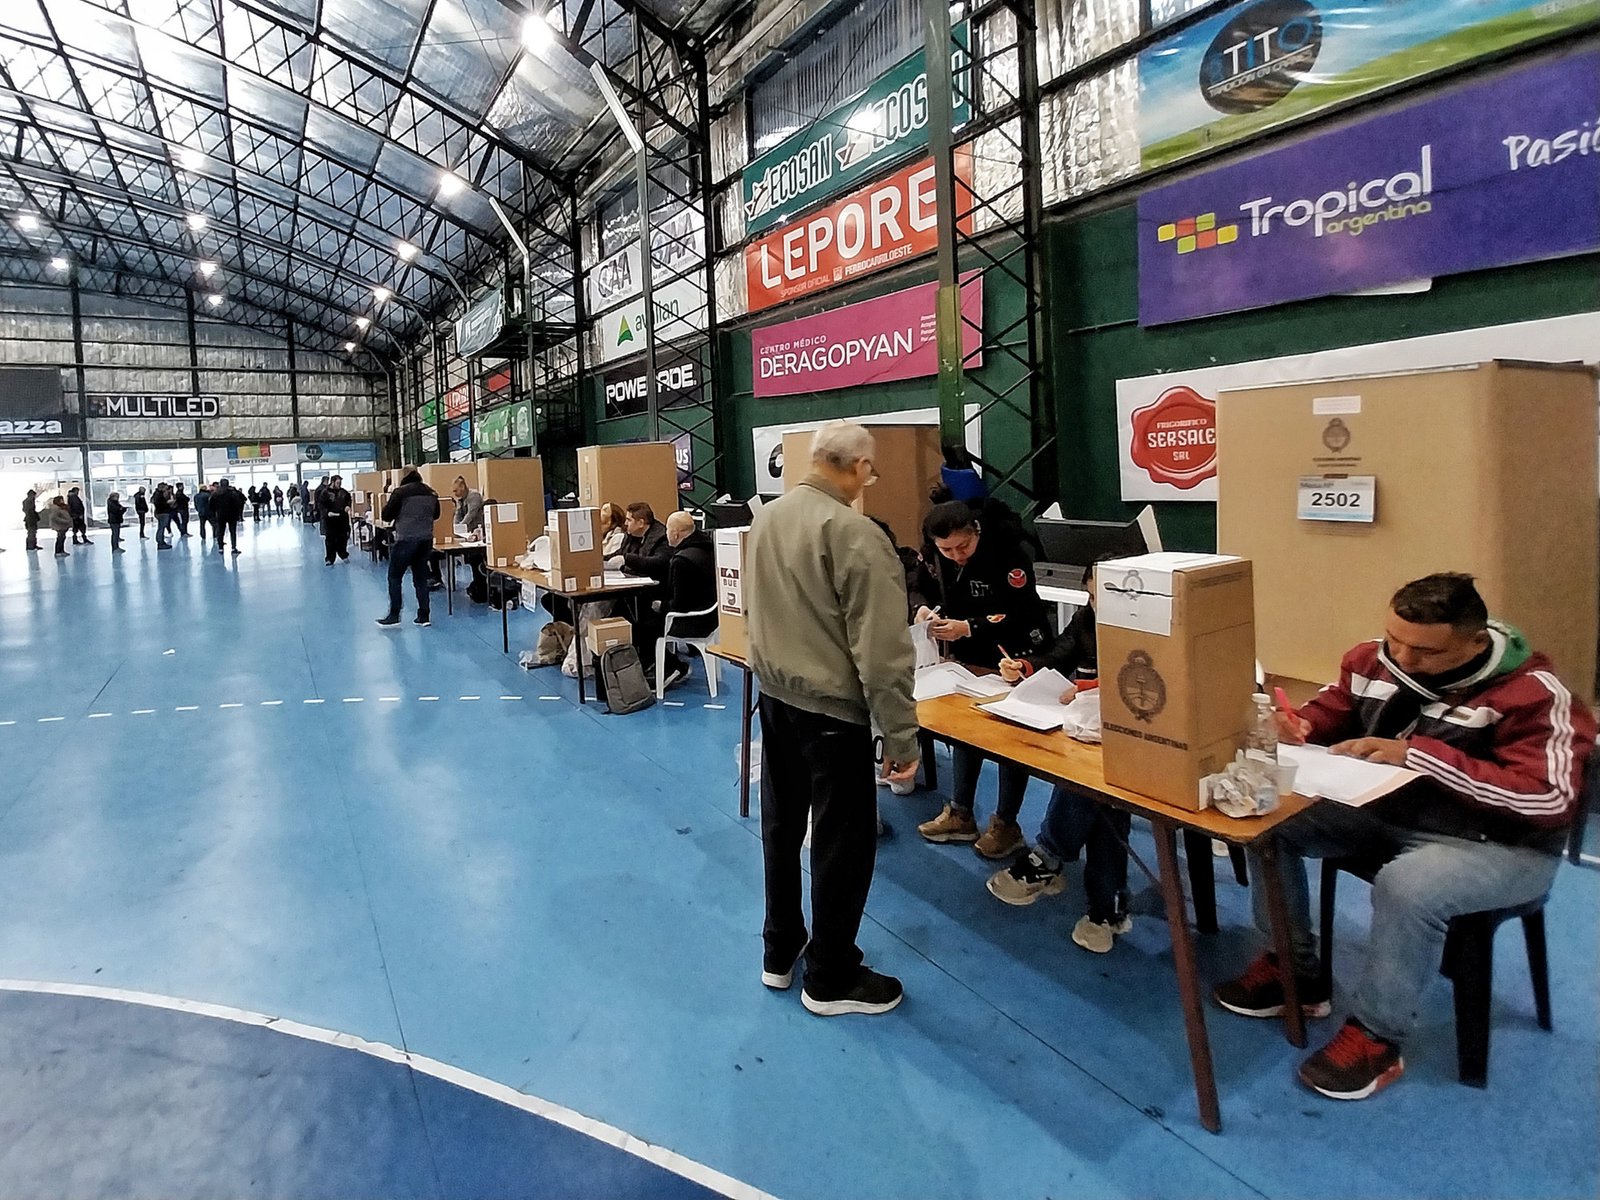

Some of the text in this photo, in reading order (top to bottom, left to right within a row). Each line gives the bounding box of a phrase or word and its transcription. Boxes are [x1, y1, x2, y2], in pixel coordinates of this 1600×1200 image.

[1223, 17, 1313, 76] TITO
[769, 134, 833, 206] ECOSAN
[1239, 144, 1432, 238] Tropical
[760, 164, 937, 289] LEPORE
[1326, 201, 1432, 236] argentina
[760, 334, 827, 355] CENTRO MÉDICO
[760, 328, 913, 378] DERAGOPYAN
[106, 396, 219, 416] MULTILED
[0, 420, 62, 434] azza
[1147, 428, 1216, 448] SERSALE
[12, 456, 64, 464] DISVAL
[1172, 451, 1190, 461] SRL
[1311, 492, 1361, 508] 2502
